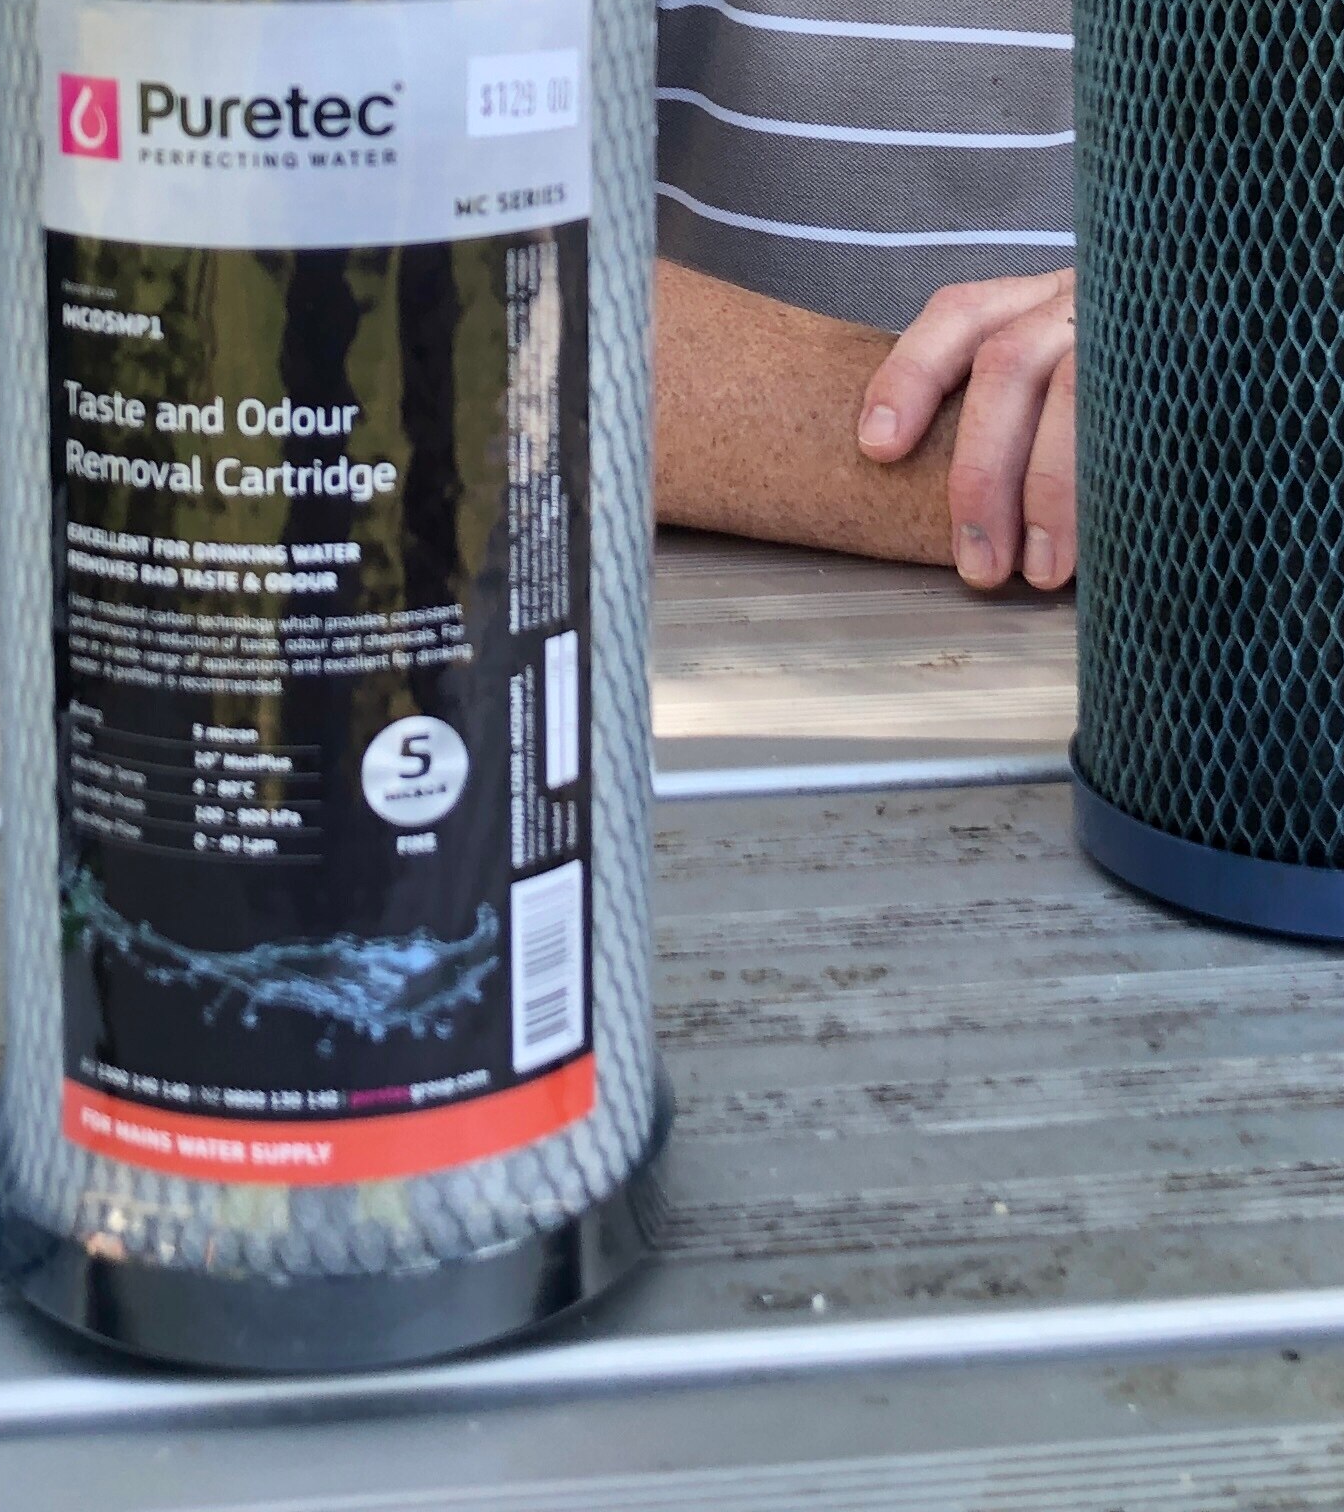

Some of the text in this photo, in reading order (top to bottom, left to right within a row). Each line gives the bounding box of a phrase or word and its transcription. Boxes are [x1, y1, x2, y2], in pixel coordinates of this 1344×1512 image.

[138, 81, 395, 140] Puretec
[138, 147, 399, 169] PERFECTING WATER
[454, 181, 566, 217] MC SERIES
[63, 378, 361, 438] Taste and Odour
[64, 438, 398, 503] Removal Cartridge
[67, 521, 150, 557] EXCELLENT
[152, 536, 192, 561] FOR
[291, 540, 362, 566] WATER
[140, 562, 179, 588] BAD
[180, 566, 240, 591] TASTE
[398, 733, 432, 780] 5
[80, 1106, 334, 1167] FOR MAINS WATER SUPPLY
